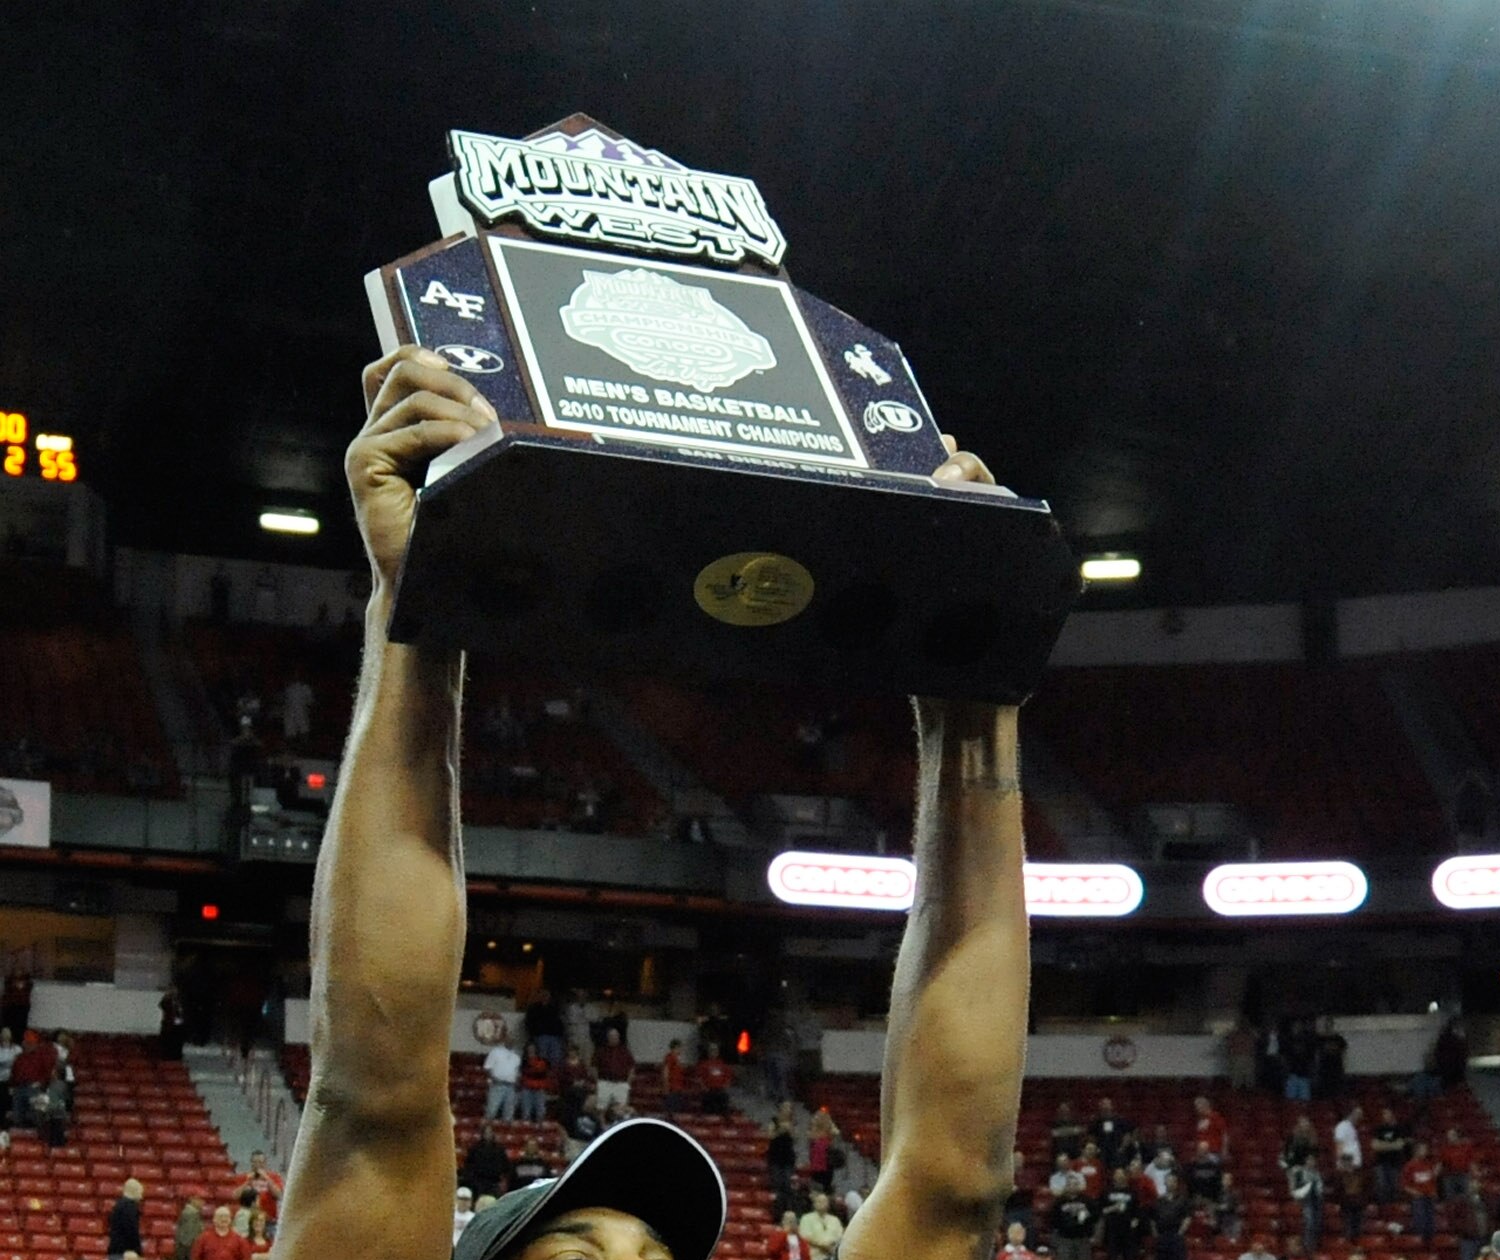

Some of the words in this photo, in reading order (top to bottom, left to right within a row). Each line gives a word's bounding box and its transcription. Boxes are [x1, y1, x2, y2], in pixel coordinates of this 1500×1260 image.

[471, 141, 769, 244] MOUNTAIN
[520, 202, 745, 259] WEST
[419, 280, 485, 319] AF
[579, 311, 757, 347] CHAMPIONSHIPS
[622, 333, 724, 356] conoco
[558, 400, 605, 421] 2010
[606, 405, 733, 438] TOURNAMENT
[736, 423, 845, 453] CHAMPIONS
[563, 376, 650, 404] MEN'S
[652, 388, 821, 428] BASKETBALL
